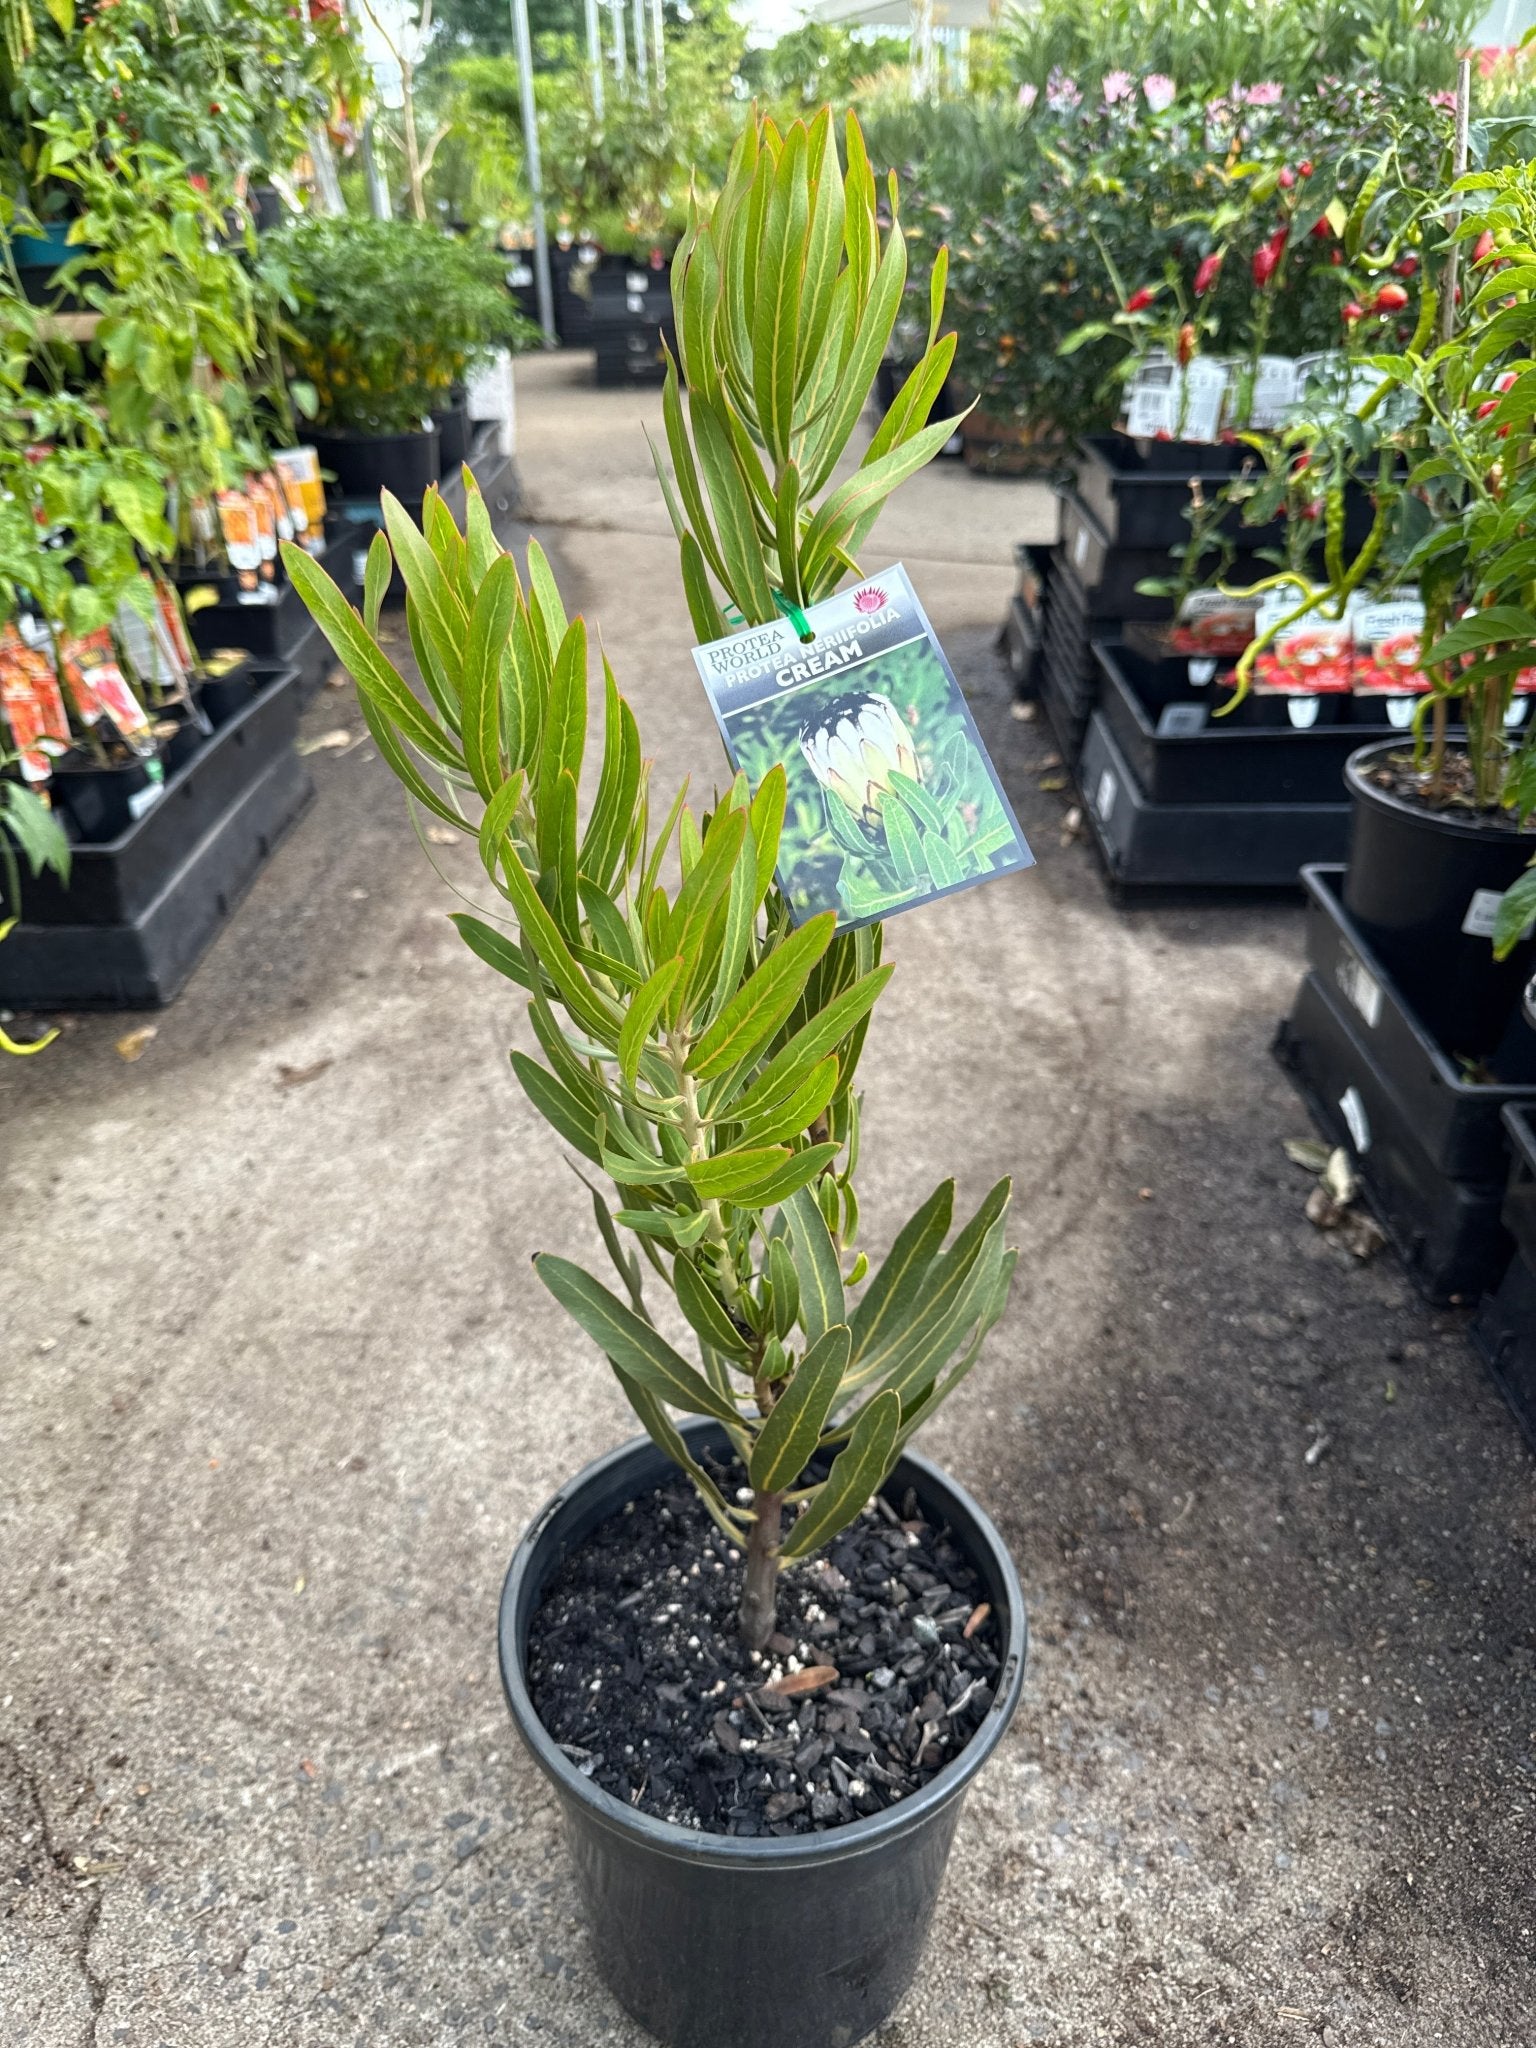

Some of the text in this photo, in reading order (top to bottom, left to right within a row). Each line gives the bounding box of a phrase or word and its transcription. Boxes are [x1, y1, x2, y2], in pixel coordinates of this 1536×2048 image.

[708, 630, 784, 663] PROTEA
[712, 643, 781, 674] WORLD
[725, 608, 901, 688] PROTEA NERIIFOLIA
[776, 640, 863, 687] CREAM
